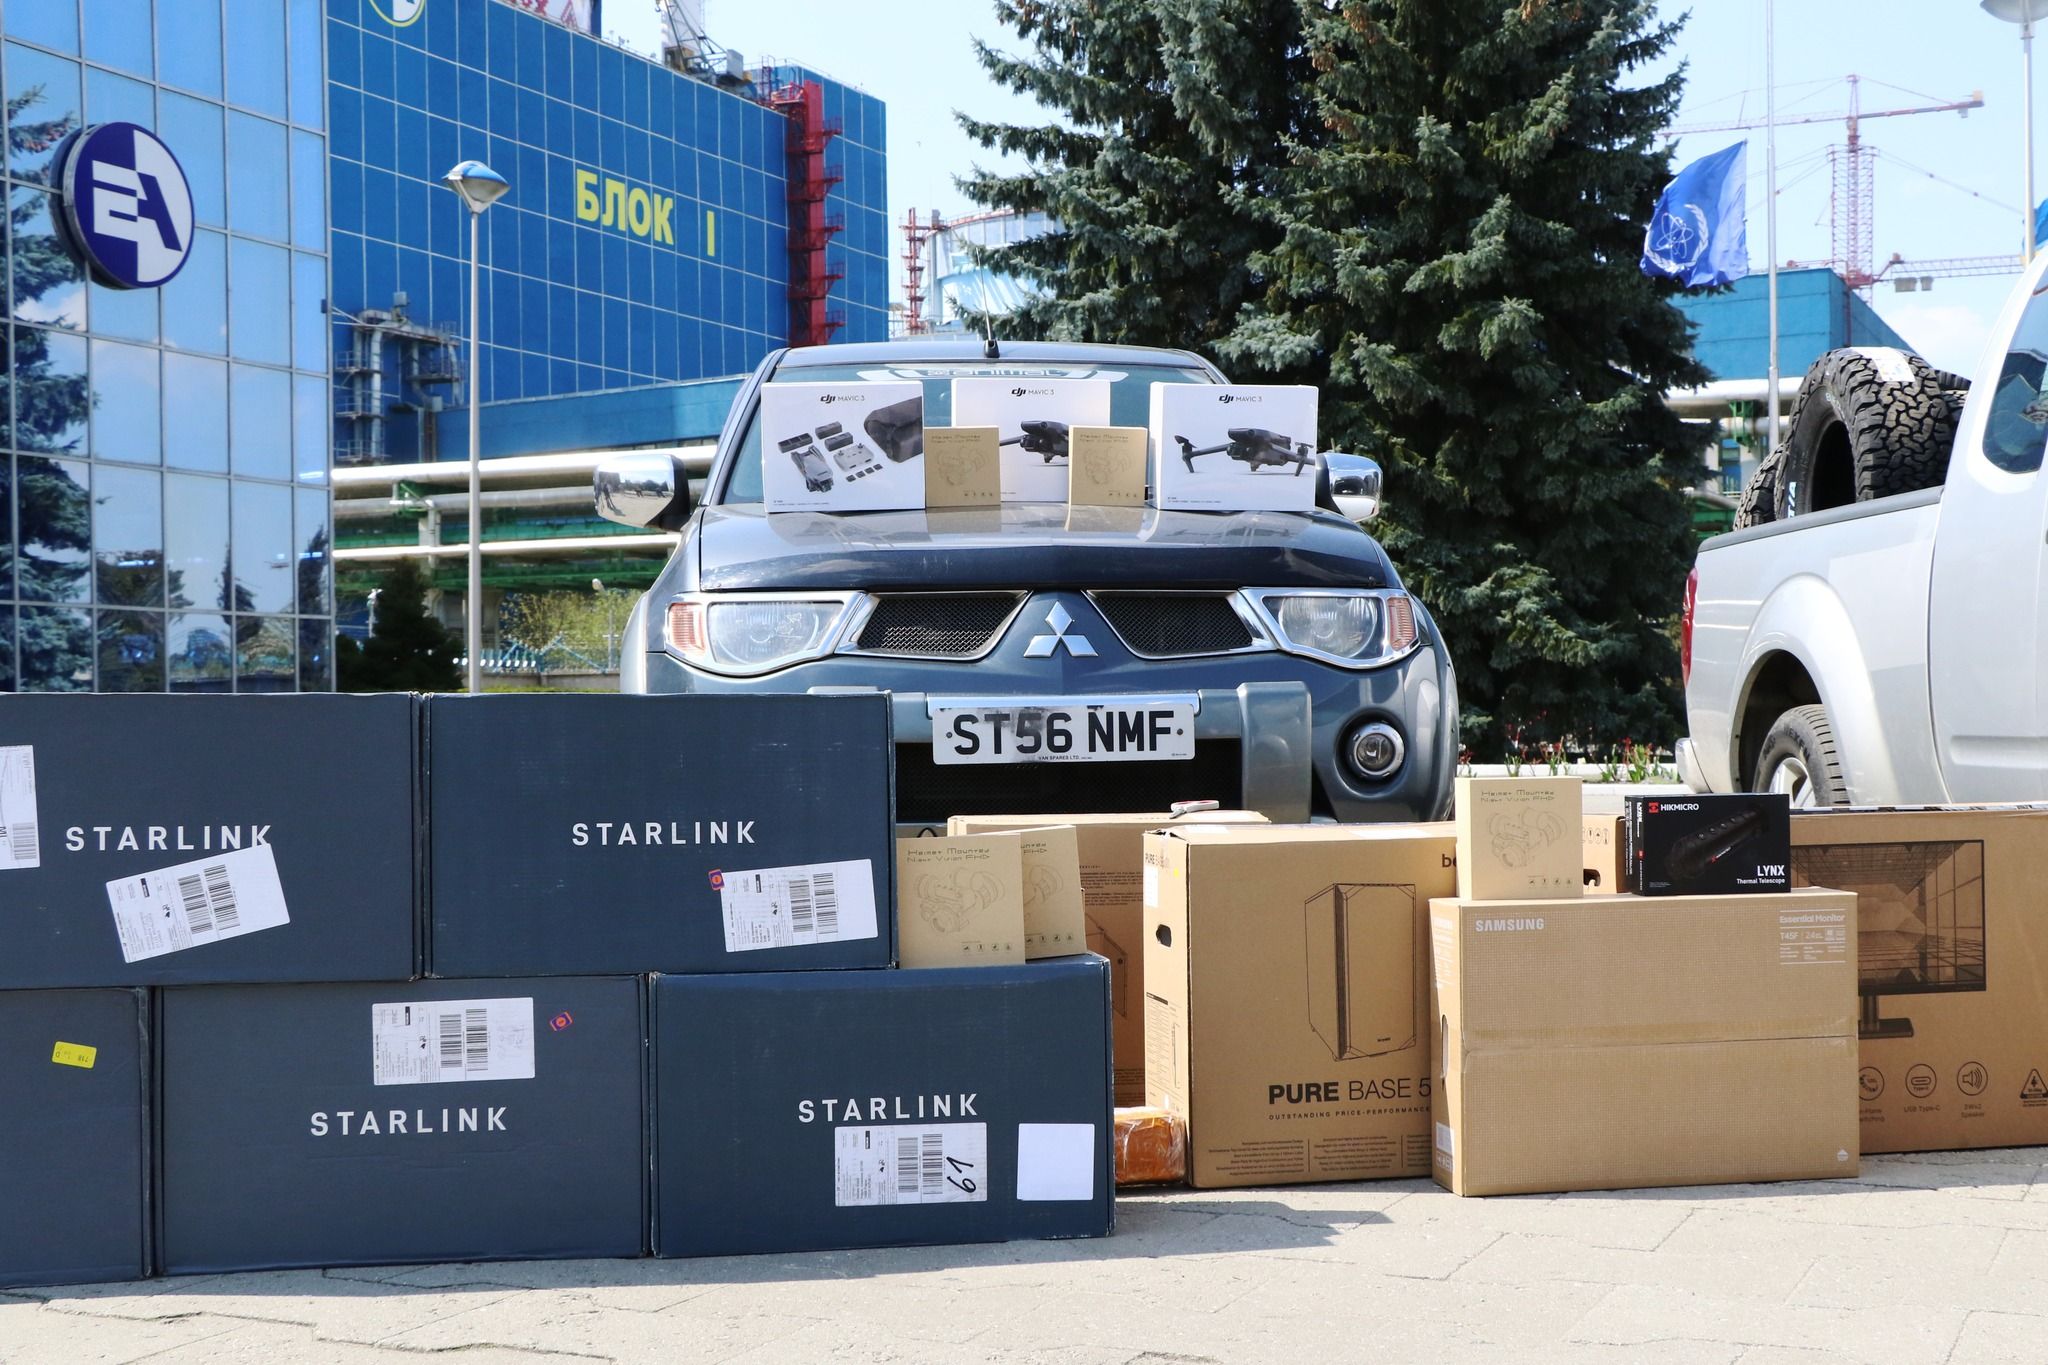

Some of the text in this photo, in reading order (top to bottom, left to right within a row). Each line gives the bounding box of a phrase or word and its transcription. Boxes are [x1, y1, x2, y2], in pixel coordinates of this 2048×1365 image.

[576, 168, 674, 245] БЛОК
[953, 710, 1174, 756] ST56 NMF
[1660, 803, 1699, 811] HIKMICRO
[66, 825, 272, 852] STARLINK
[573, 821, 755, 846] STARLINK
[1757, 865, 1785, 876] LYNX
[1475, 918, 1545, 932] SAMSUNG
[1780, 914, 1846, 923] Essential Monitor
[1269, 1078, 1431, 1105] PURE BASE 5
[798, 1094, 977, 1123] STARLINK
[1269, 1107, 1430, 1121] OUTSTANDING PRICE-PERFORMANCE
[311, 1107, 507, 1137] STARLINK
